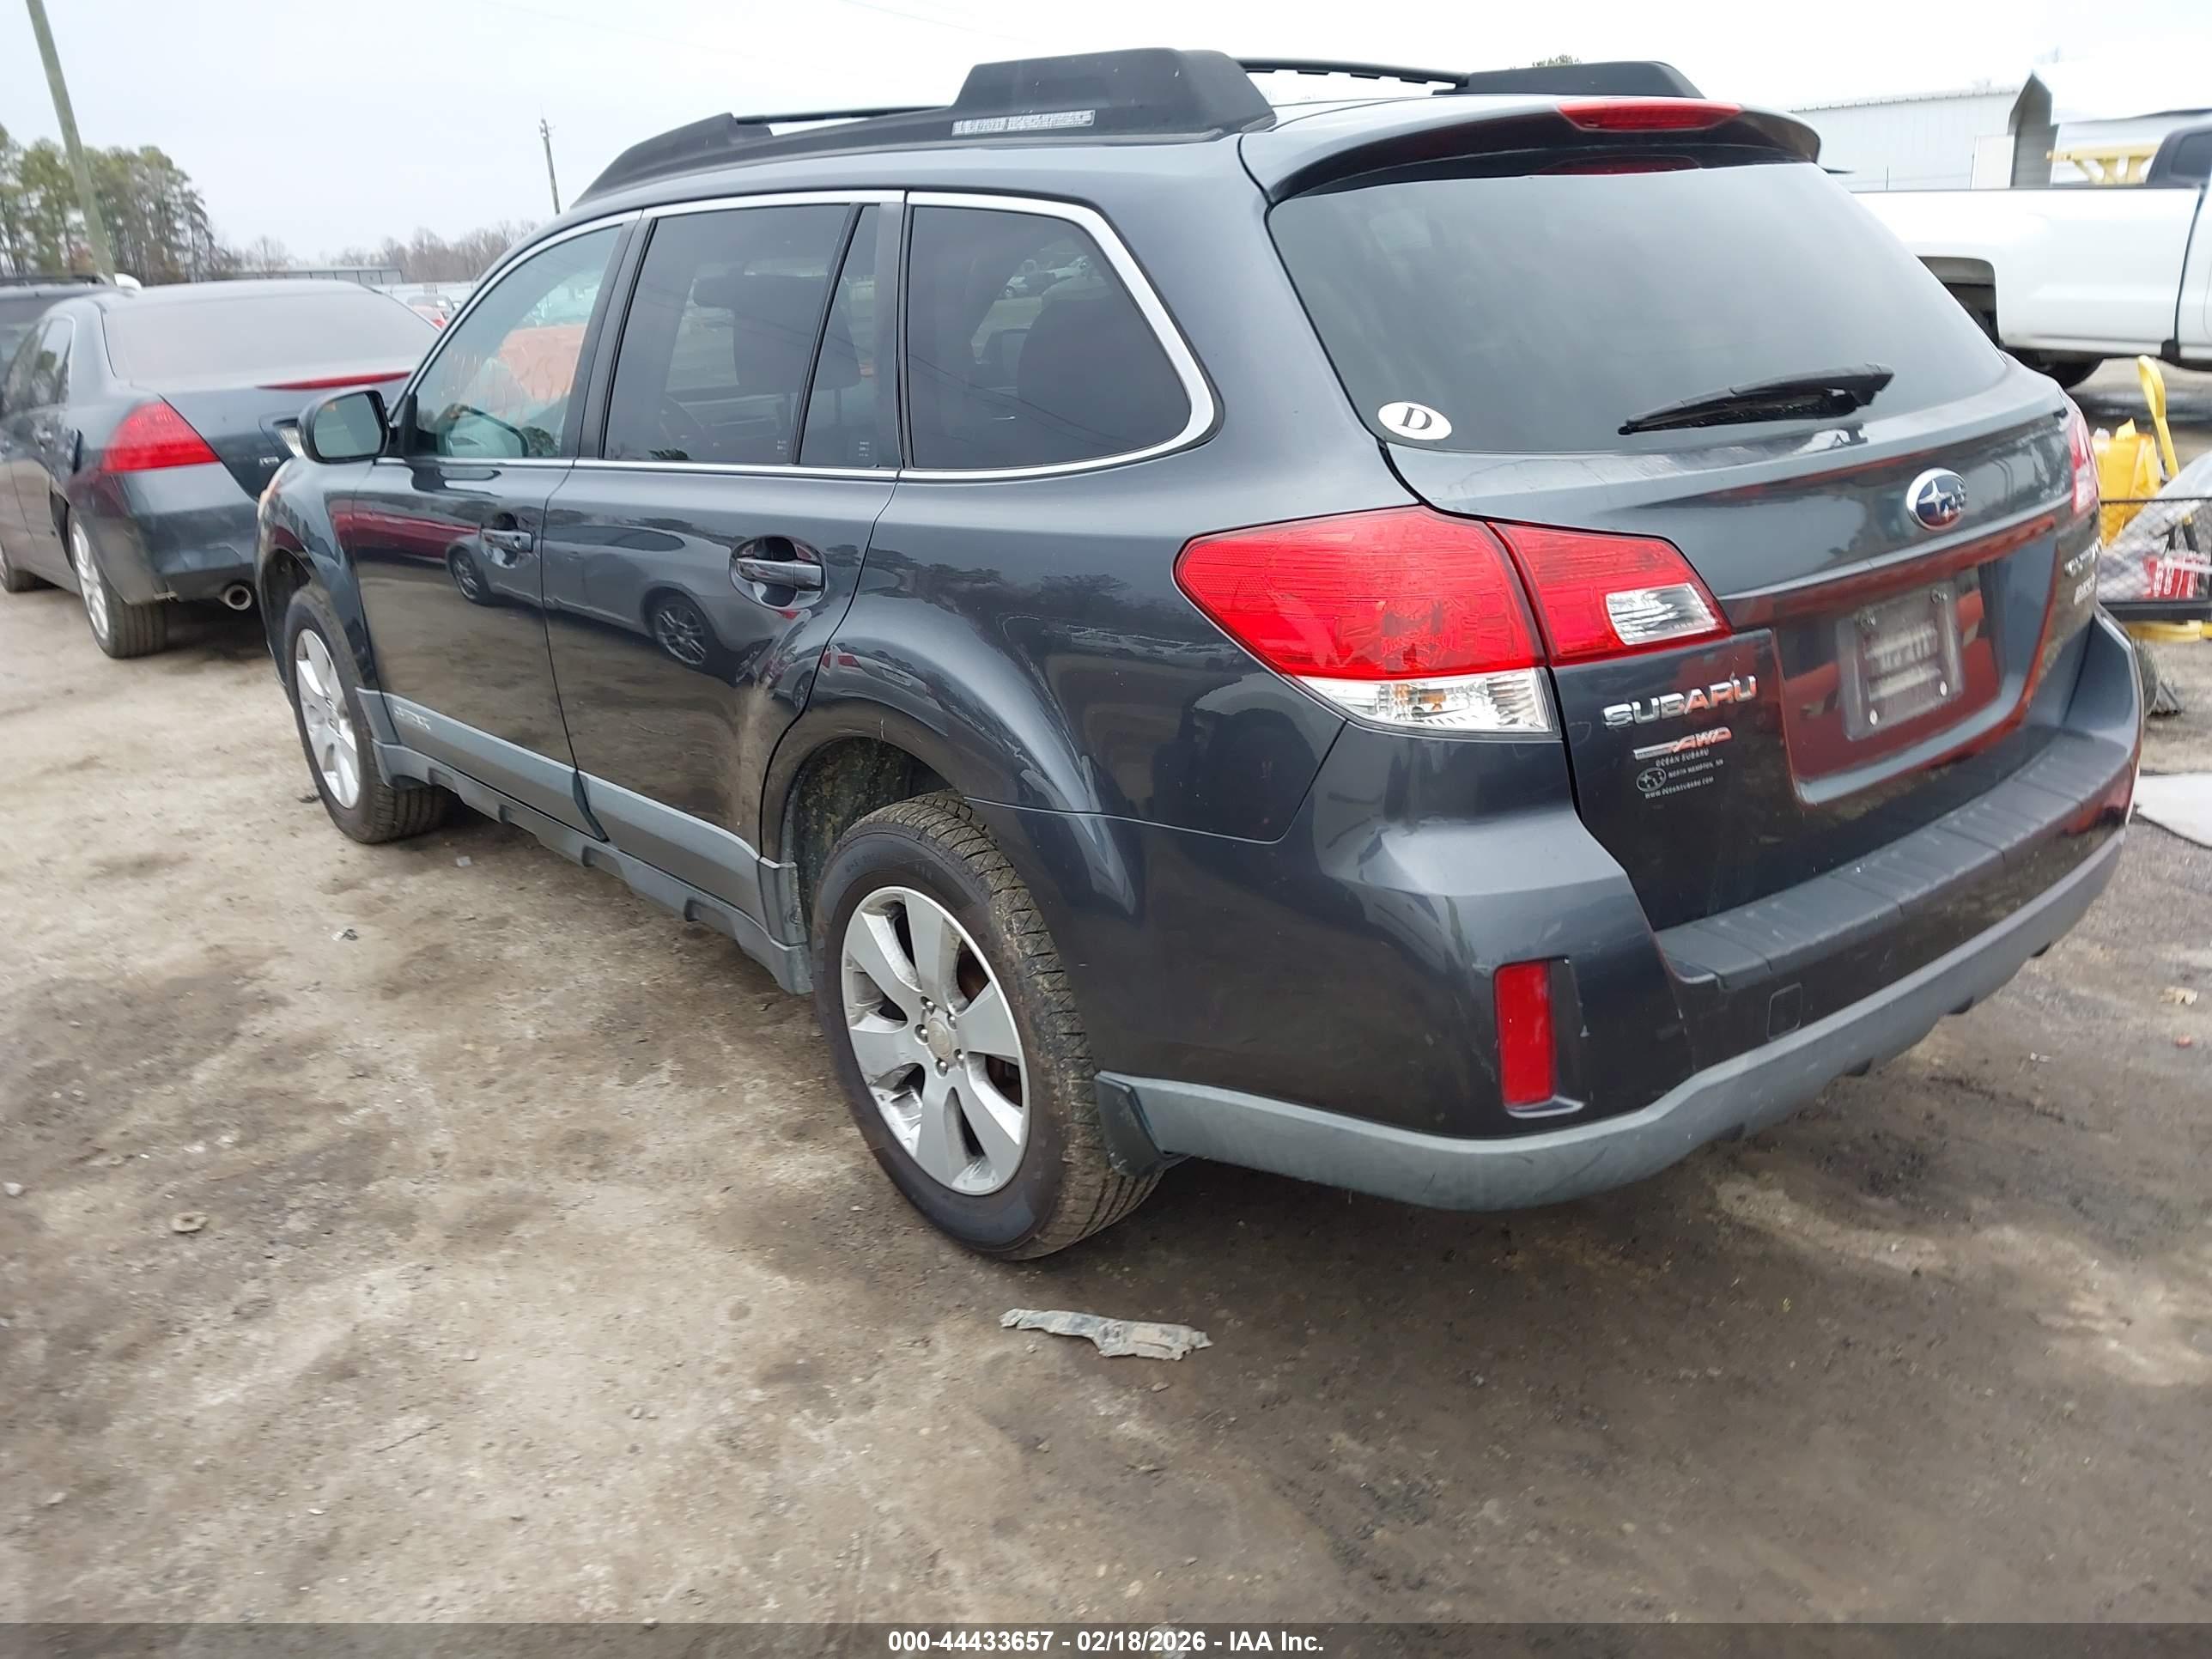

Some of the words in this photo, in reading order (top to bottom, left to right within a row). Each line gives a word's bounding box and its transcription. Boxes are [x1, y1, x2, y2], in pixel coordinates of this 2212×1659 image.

[1398, 405, 1432, 430] D
[1603, 675, 1757, 727] SUBARU
[1673, 726, 1732, 752] AWD
